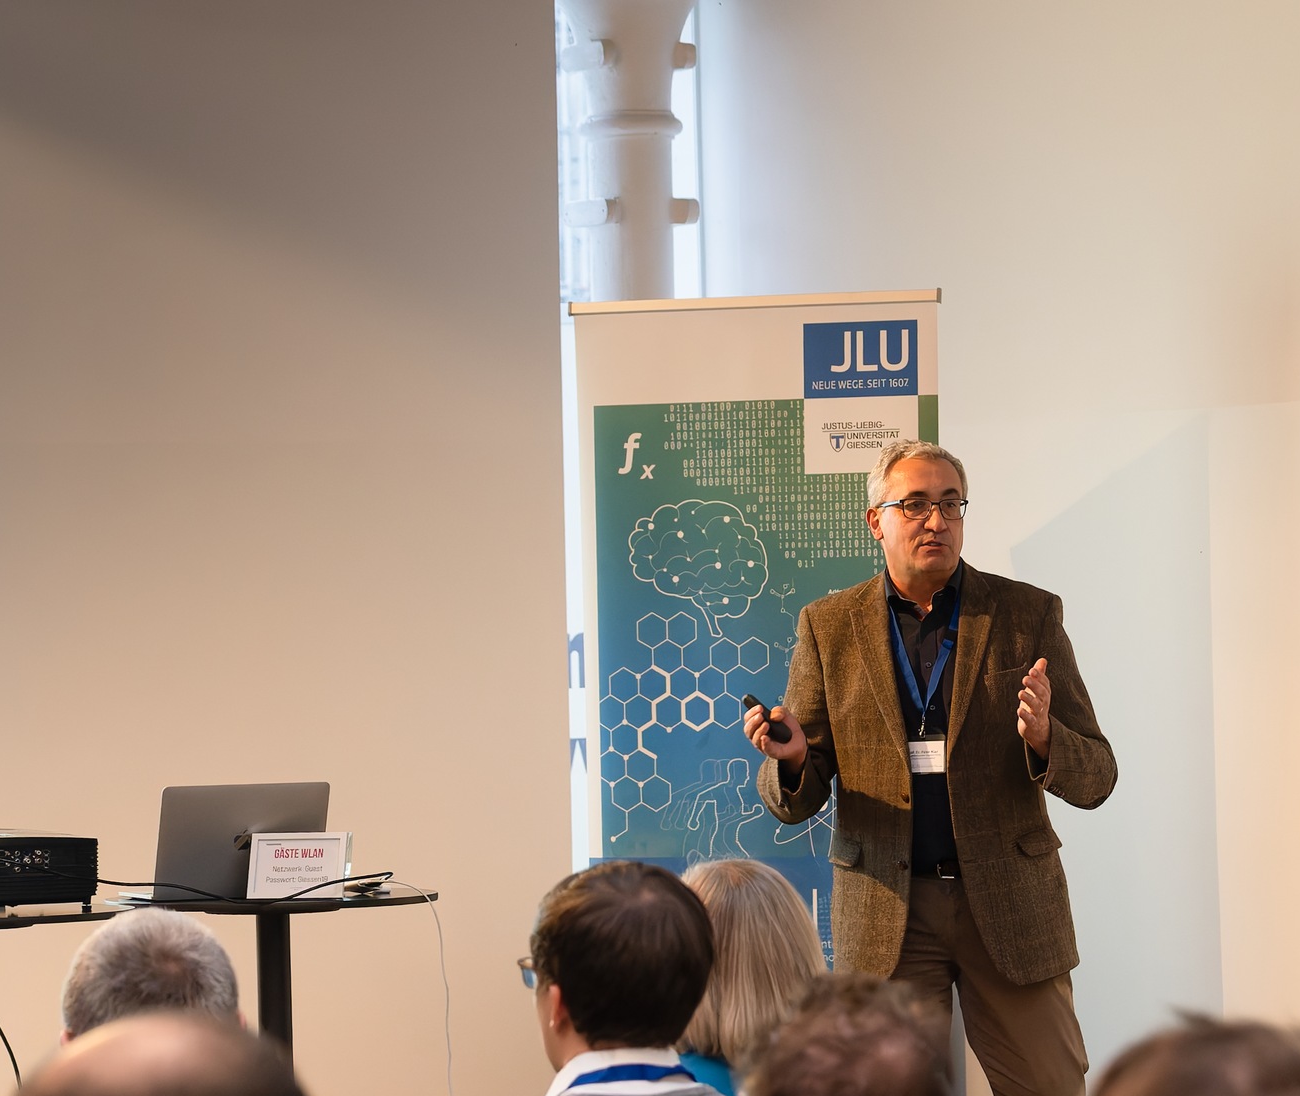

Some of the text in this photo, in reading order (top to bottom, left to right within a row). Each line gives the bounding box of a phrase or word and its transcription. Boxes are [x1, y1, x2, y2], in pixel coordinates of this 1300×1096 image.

[830, 329, 909, 373] JLU
[812, 381, 836, 390] NEUE
[822, 421, 885, 430] JUSTUS-LIEBIG-
[847, 441, 883, 449] GIESSEN
[274, 847, 324, 859] GÄSTE WLAN
